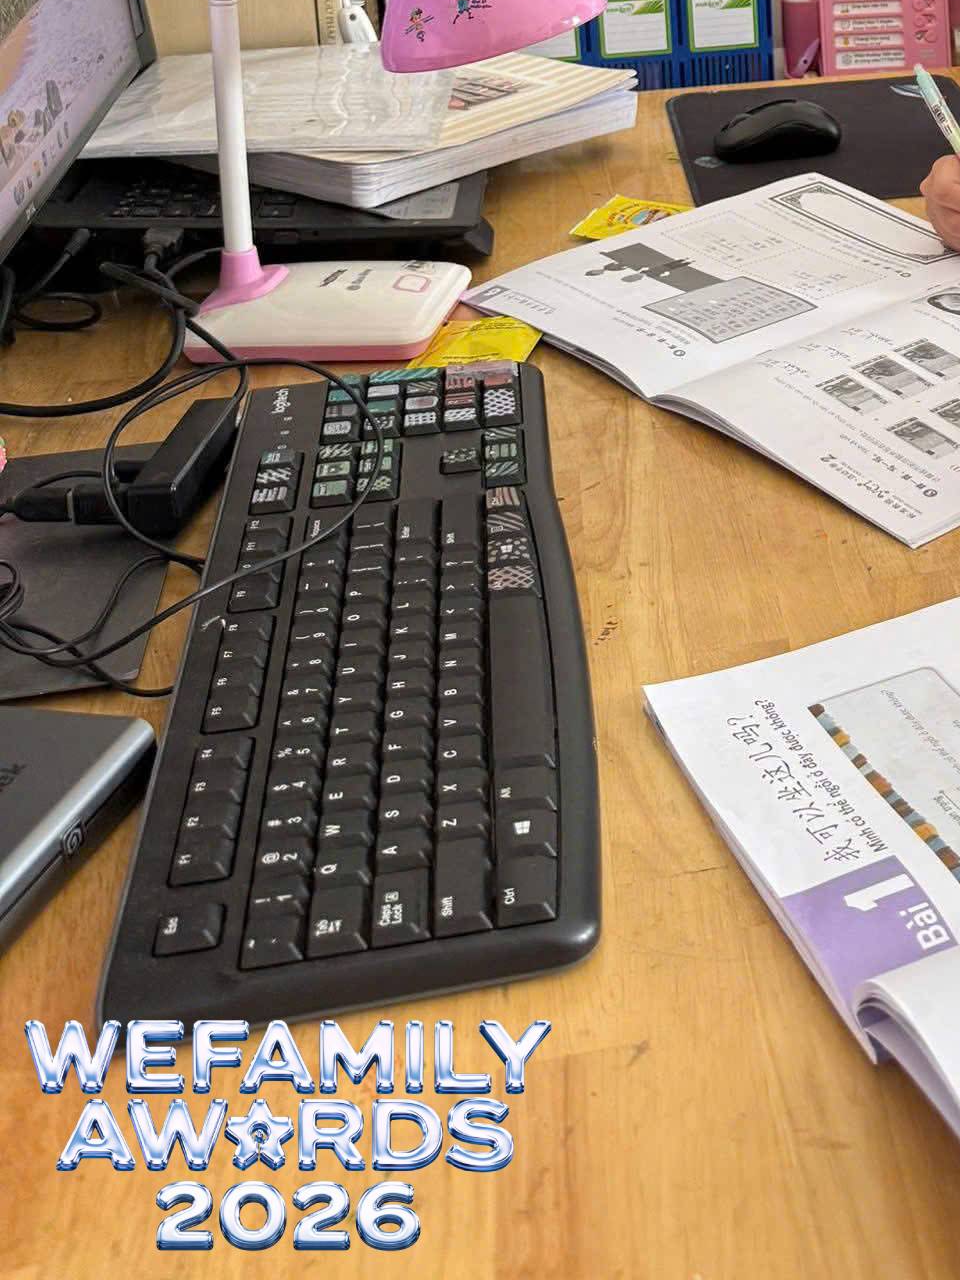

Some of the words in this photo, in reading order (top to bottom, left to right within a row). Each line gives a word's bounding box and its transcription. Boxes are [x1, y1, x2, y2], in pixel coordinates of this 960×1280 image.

[272, 388, 290, 414] logitech
[395, 627, 409, 635] K
[392, 681, 405, 689] H
[390, 710, 404, 718] G
[754, 699, 786, 729] không?
[781, 729, 803, 750] được
[202, 748, 213, 757] F4
[444, 750, 456, 758] C
[332, 757, 346, 767] R
[798, 752, 817, 768] đây
[387, 775, 400, 784] D
[195, 781, 206, 791] F3
[443, 783, 457, 791] X
[814, 777, 840, 804] ngồi
[329, 791, 343, 800] E
[832, 798, 854, 815] thể
[385, 810, 400, 818] S
[187, 816, 200, 827] F2
[443, 818, 457, 827] Z
[845, 815, 865, 826] có
[325, 825, 341, 837] W
[859, 827, 887, 852] Mình
[382, 846, 398, 855] A
[178, 854, 192, 864] F1
[283, 853, 297, 861] 2
[321, 864, 337, 874] Q
[505, 887, 515, 904] Ctrl
[843, 873, 918, 912] 1
[277, 894, 293, 902] 1
[441, 896, 453, 916] Shift
[379, 905, 392, 927] Caps
[392, 903, 402, 925] Lock
[899, 891, 951, 951] Bài
[164, 918, 178, 935] Esc
